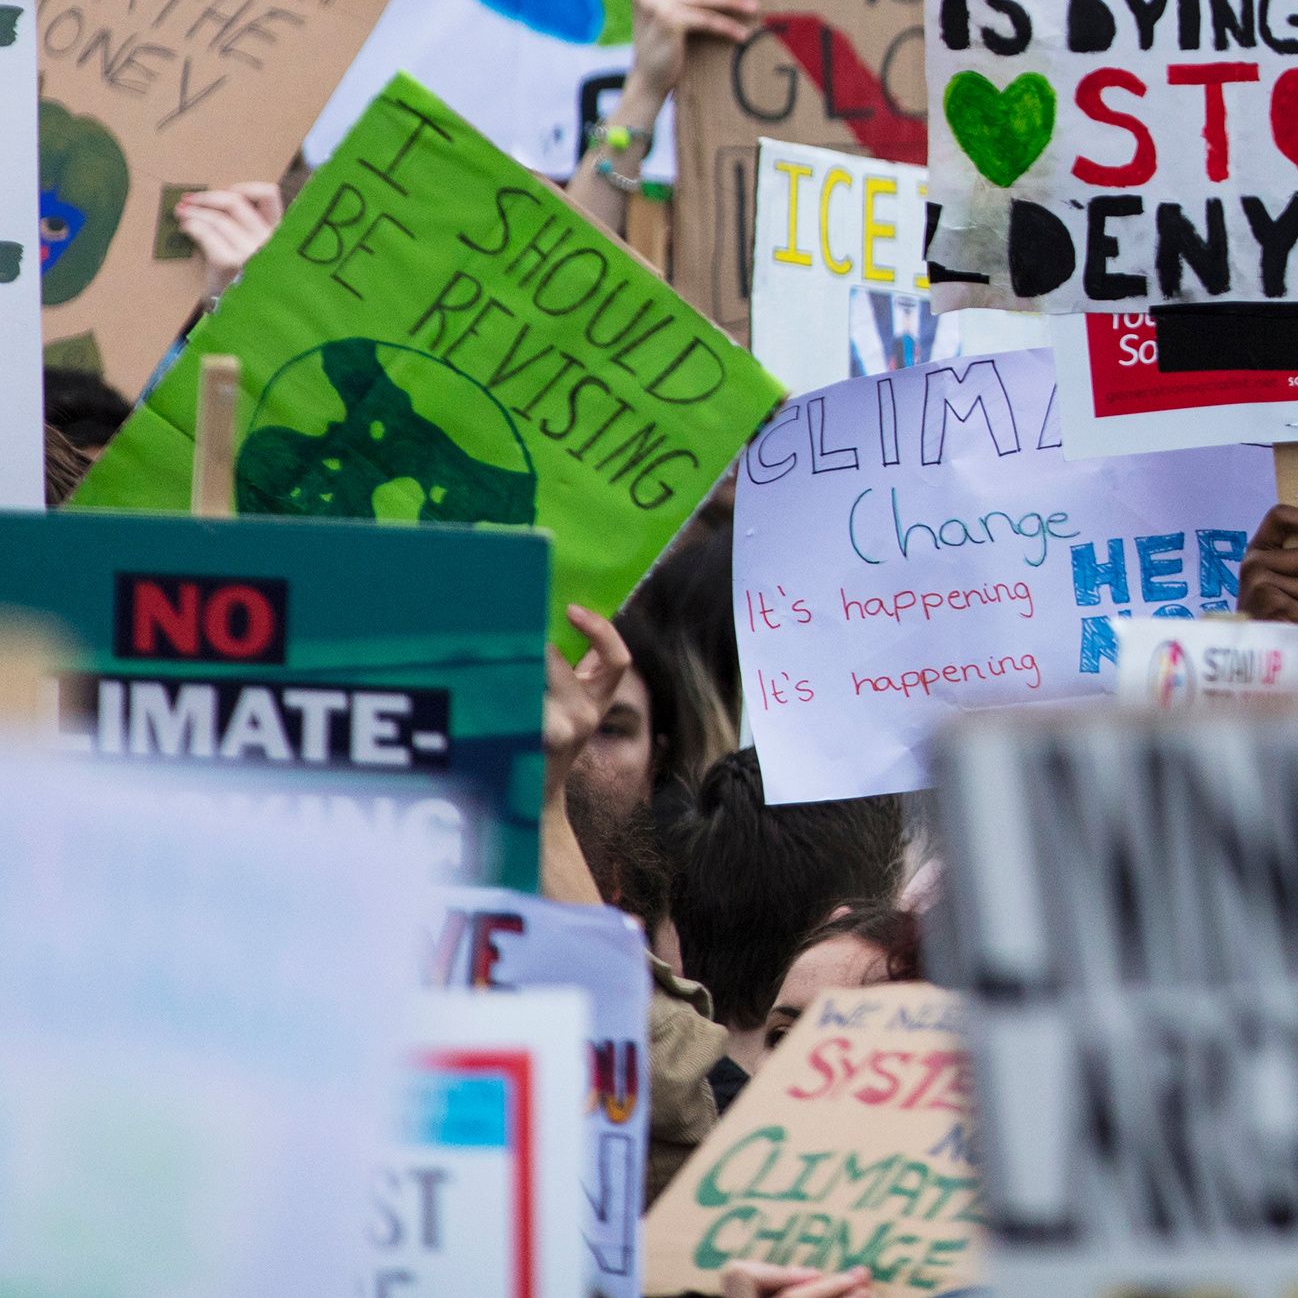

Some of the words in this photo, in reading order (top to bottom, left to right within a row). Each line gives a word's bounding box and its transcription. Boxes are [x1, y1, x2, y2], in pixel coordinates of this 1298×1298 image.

[358, 93, 455, 198] I
[456, 186, 728, 406] SHOULD
[773, 158, 898, 283] ICE
[297, 181, 415, 300] BE
[406, 270, 701, 511] REVISING
[848, 486, 1081, 569] Change
[132, 580, 276, 658] NO
[841, 582, 1035, 624] happening
[854, 653, 1041, 699] happening
[694, 1205, 970, 1290] CHANGE
